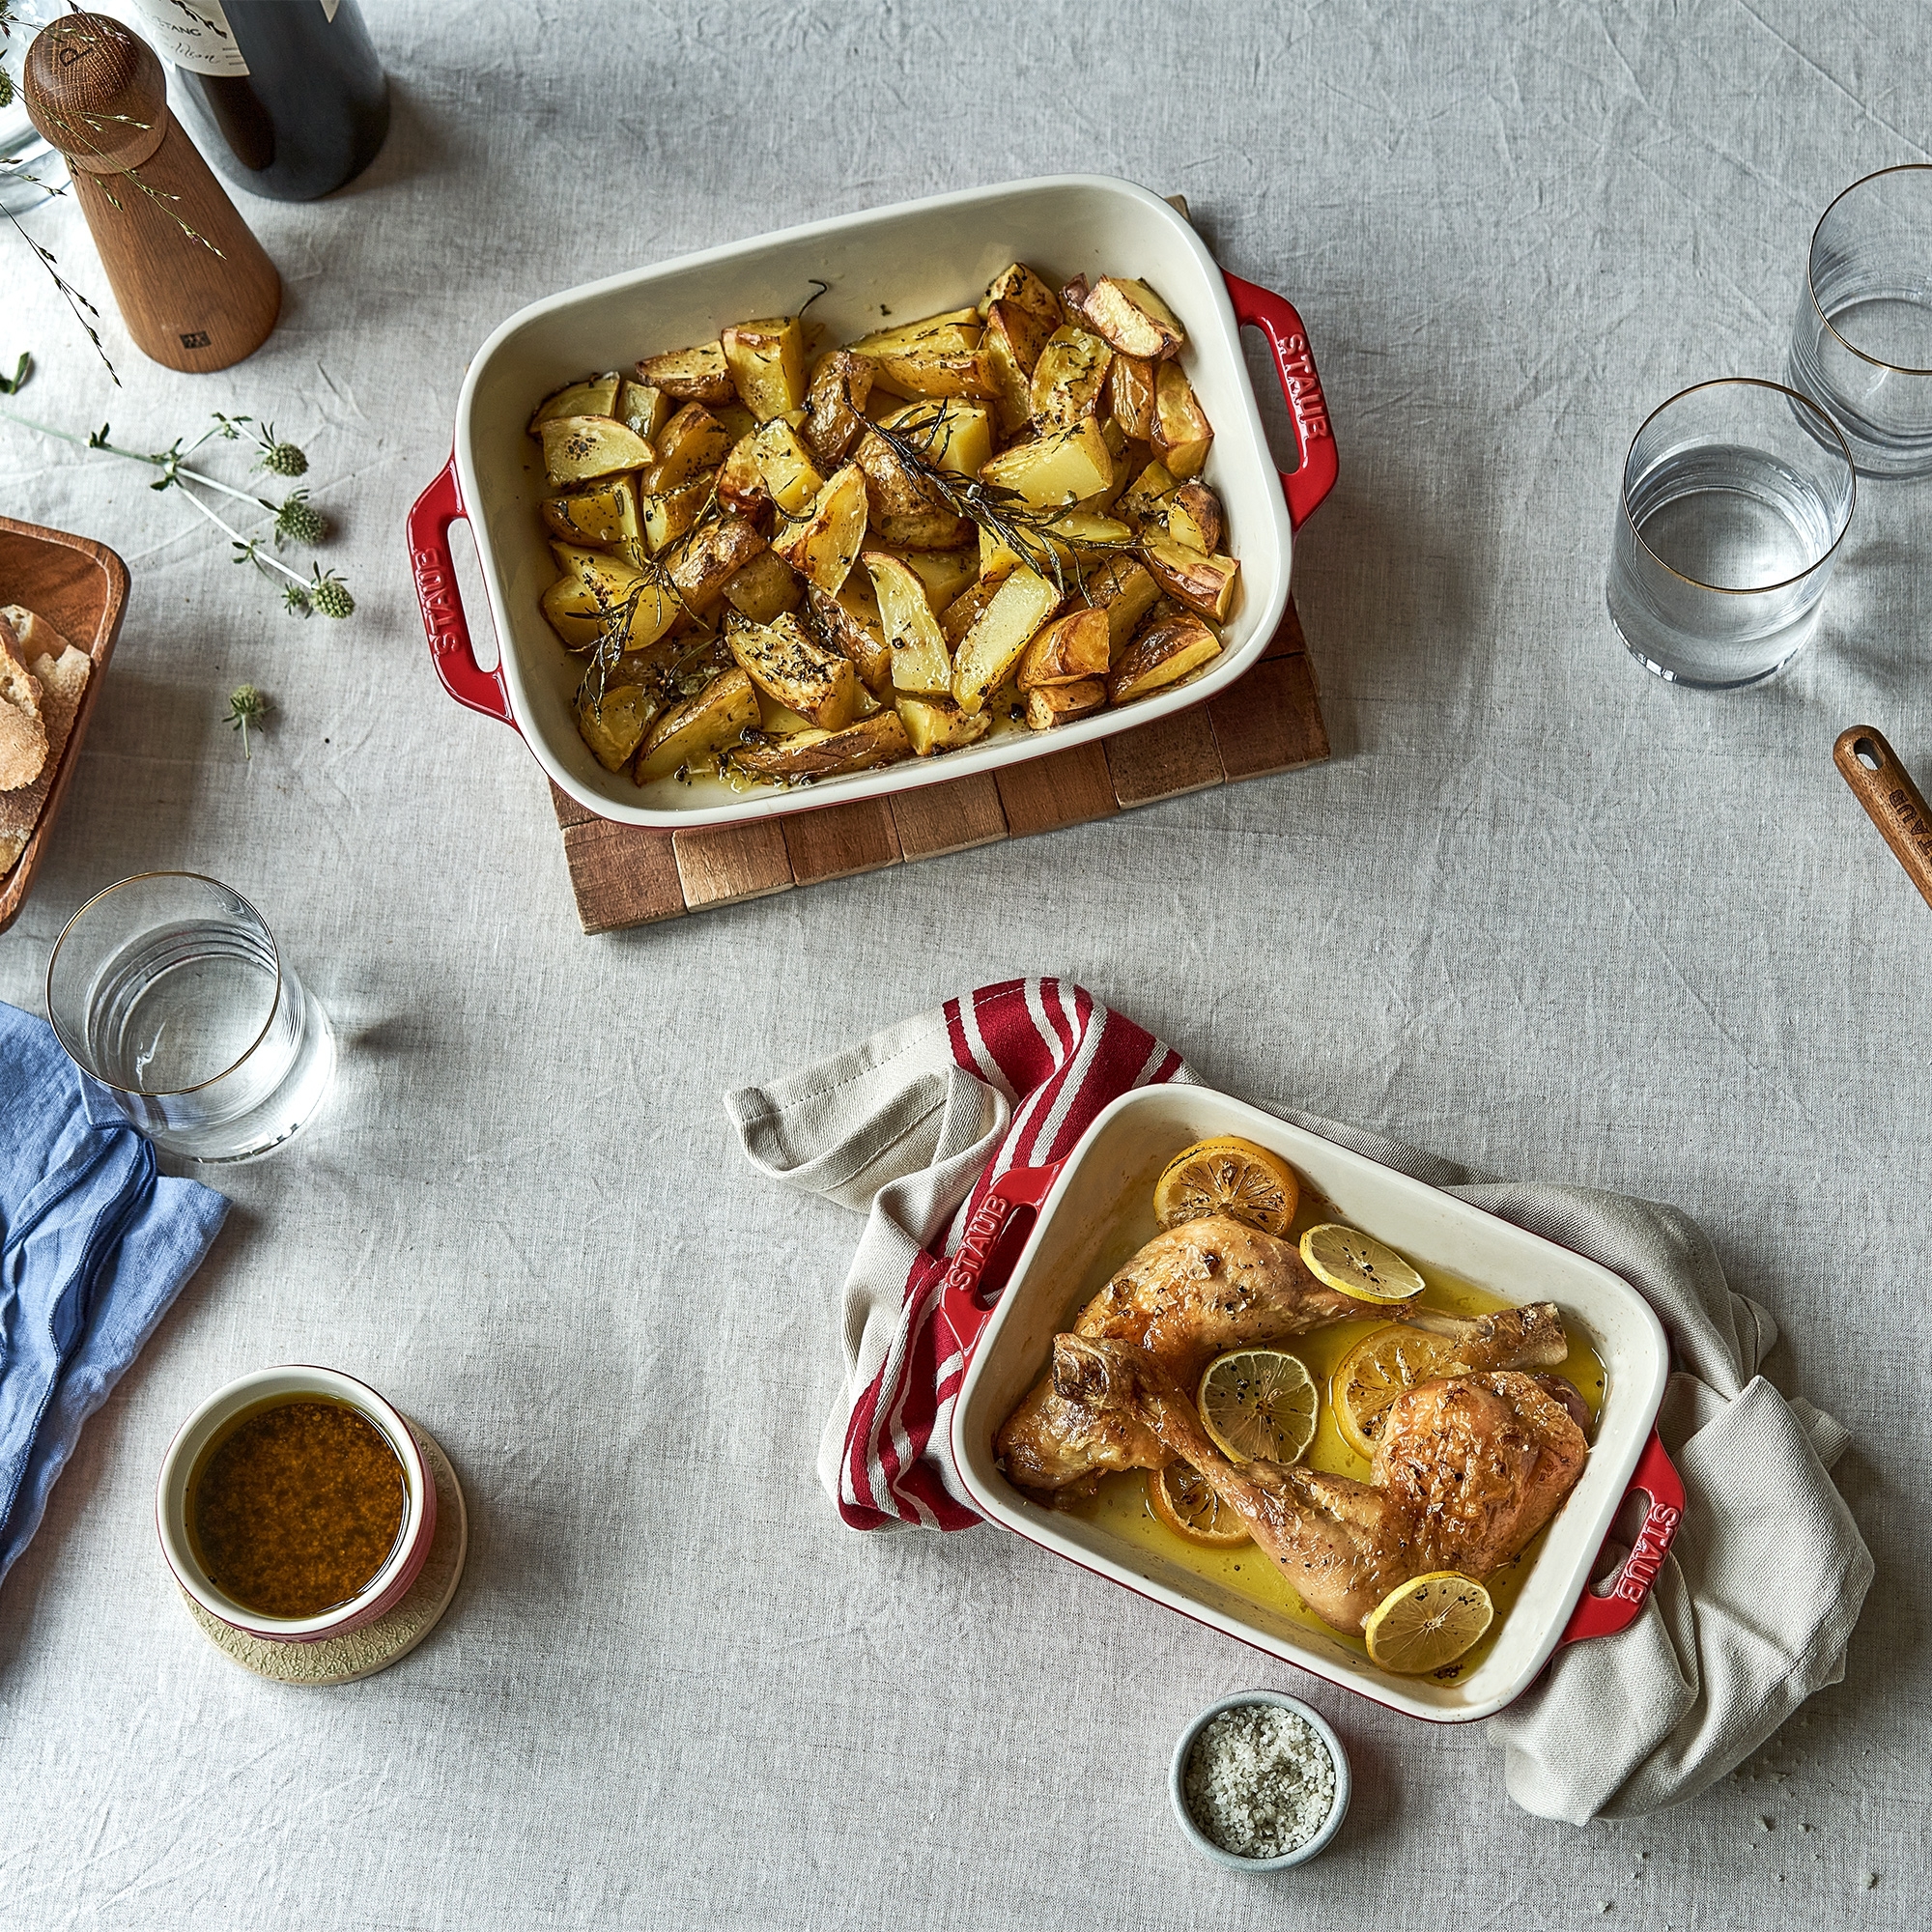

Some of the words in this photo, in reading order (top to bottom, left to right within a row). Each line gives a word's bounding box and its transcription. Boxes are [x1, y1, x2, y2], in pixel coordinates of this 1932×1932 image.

[59, 47, 93, 68] P
[1278, 333, 1328, 438] STAUB
[415, 547, 460, 655] STAUB
[1889, 789, 1932, 867] TAUB
[950, 1194, 1009, 1291] STAUB
[1619, 1503, 1680, 1604] STAUB
